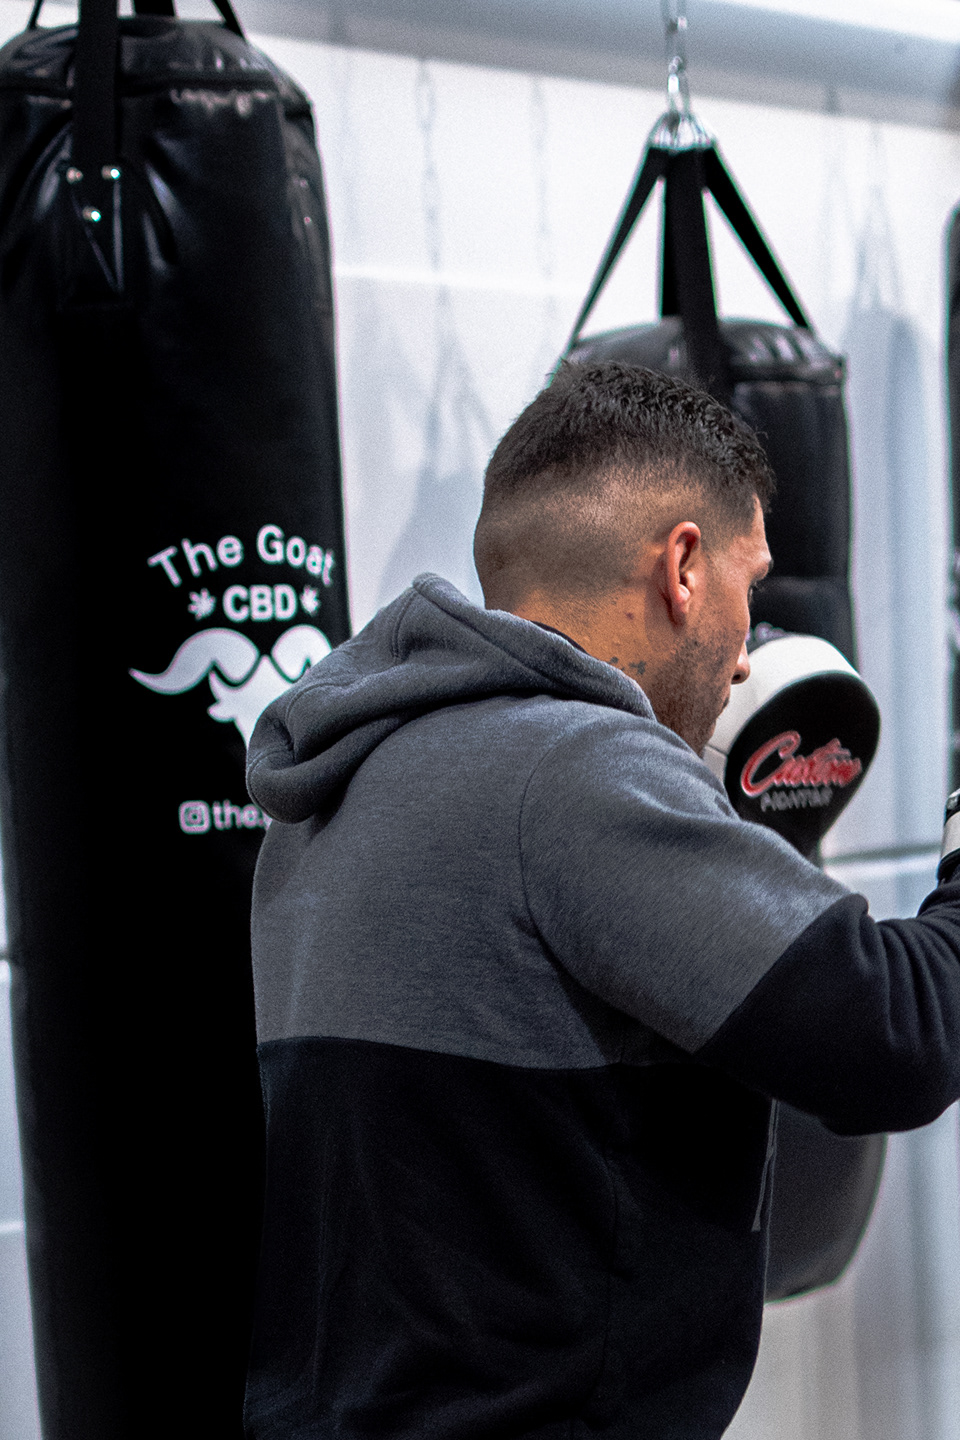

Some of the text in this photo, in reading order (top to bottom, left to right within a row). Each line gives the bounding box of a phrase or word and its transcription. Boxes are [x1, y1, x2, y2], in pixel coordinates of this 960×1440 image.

[147, 524, 334, 586] The Goat
[222, 584, 297, 622] CBD
